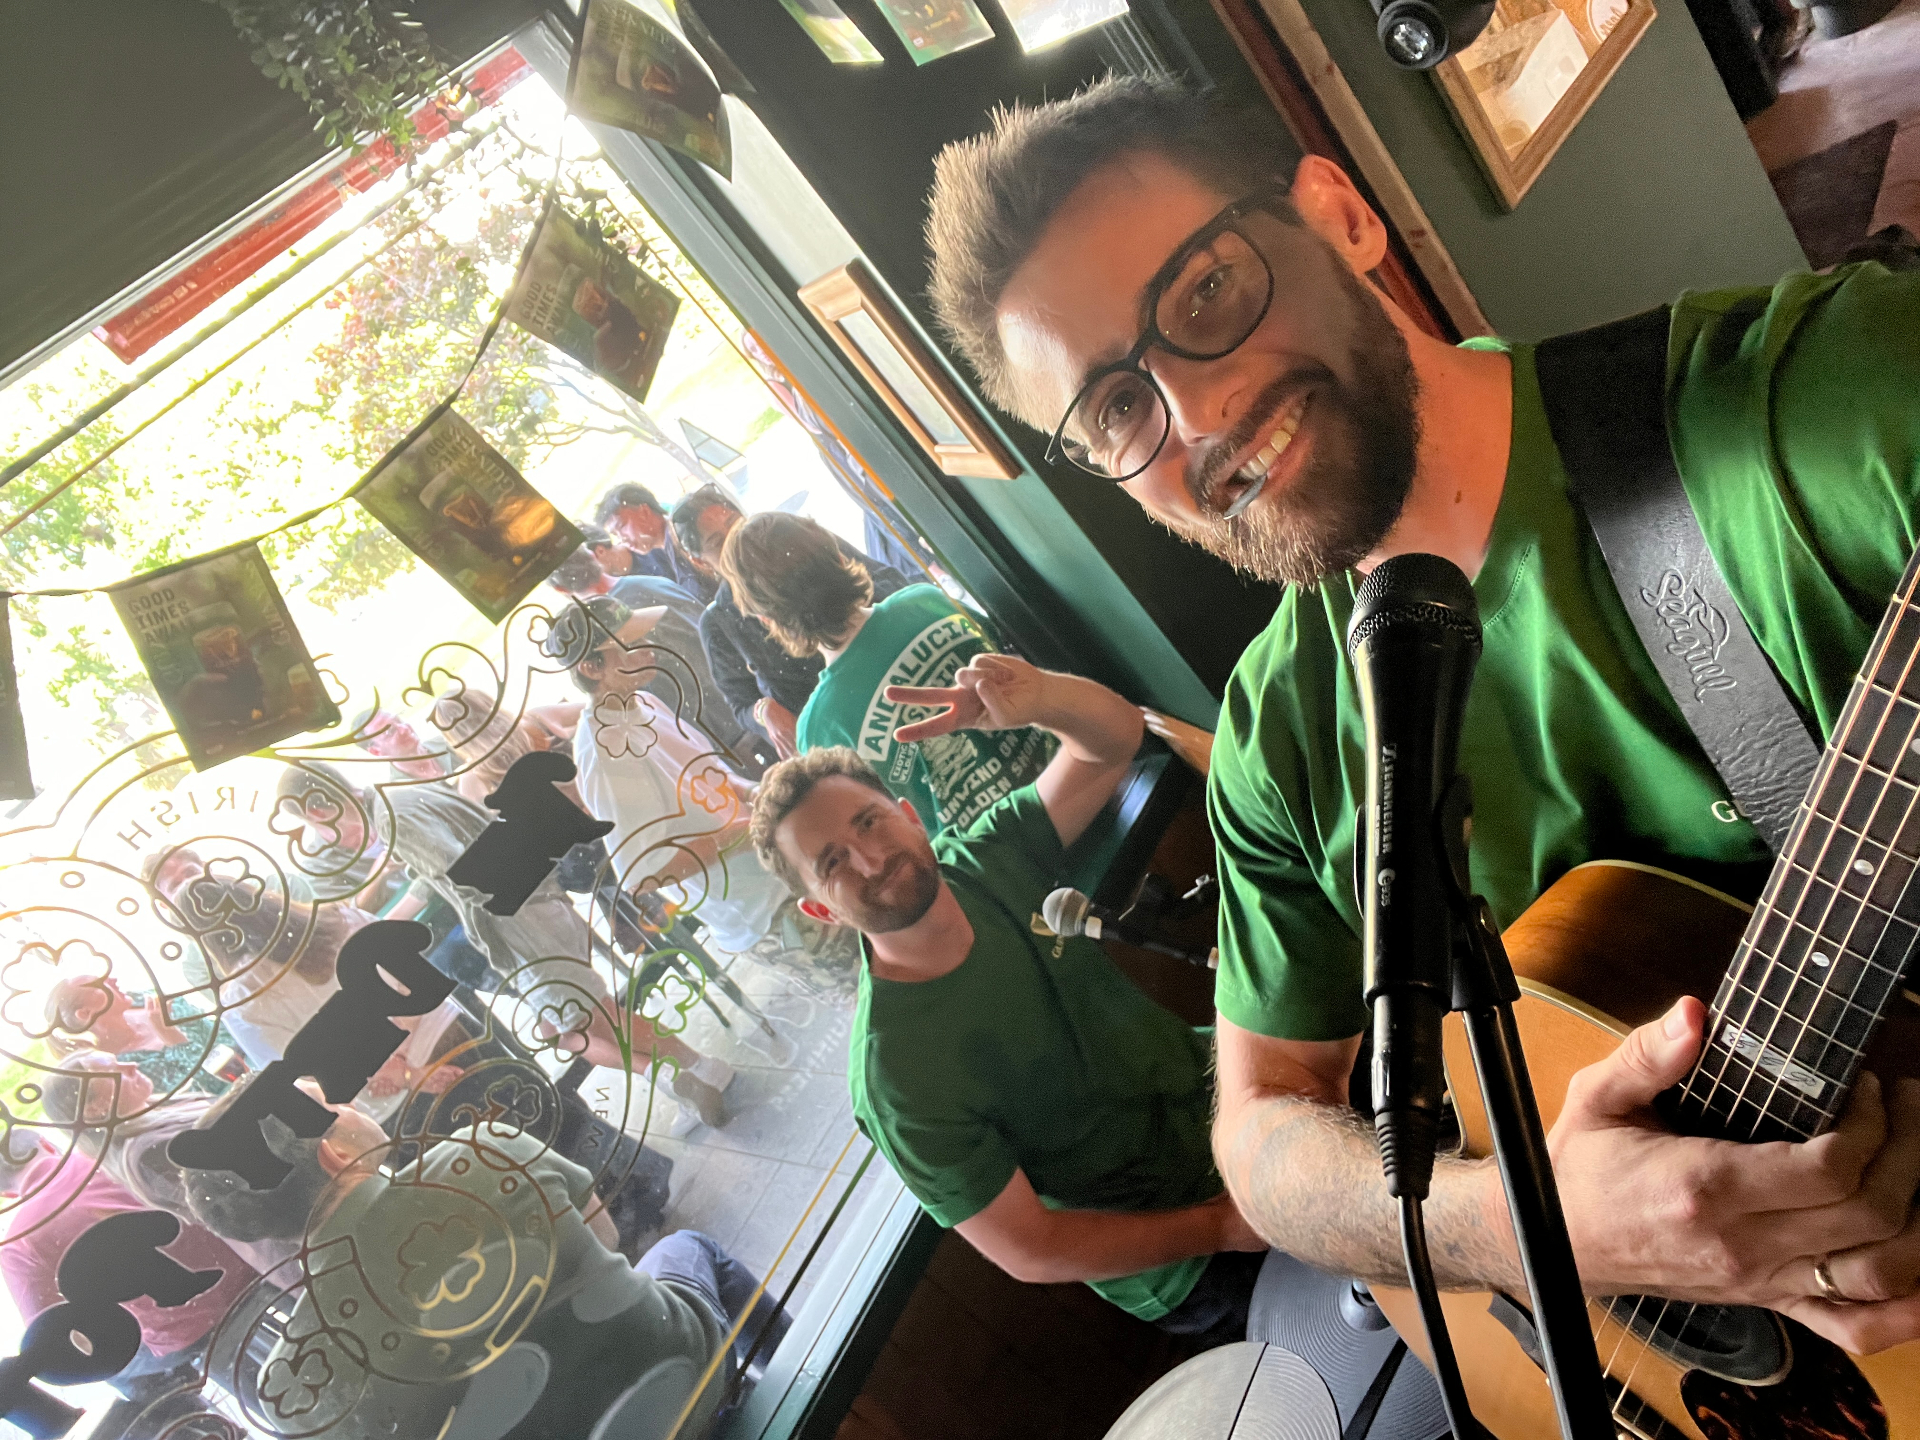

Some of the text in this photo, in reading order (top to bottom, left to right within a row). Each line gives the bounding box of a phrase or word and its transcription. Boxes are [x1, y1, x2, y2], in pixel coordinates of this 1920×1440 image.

[520, 281, 543, 320] GOOD
[531, 284, 557, 326] TIMES
[128, 587, 175, 615] GOOD
[134, 600, 190, 630] TIMES
[936, 731, 1019, 824] UNWIND ON
[957, 776, 1013, 829] OLDEN
